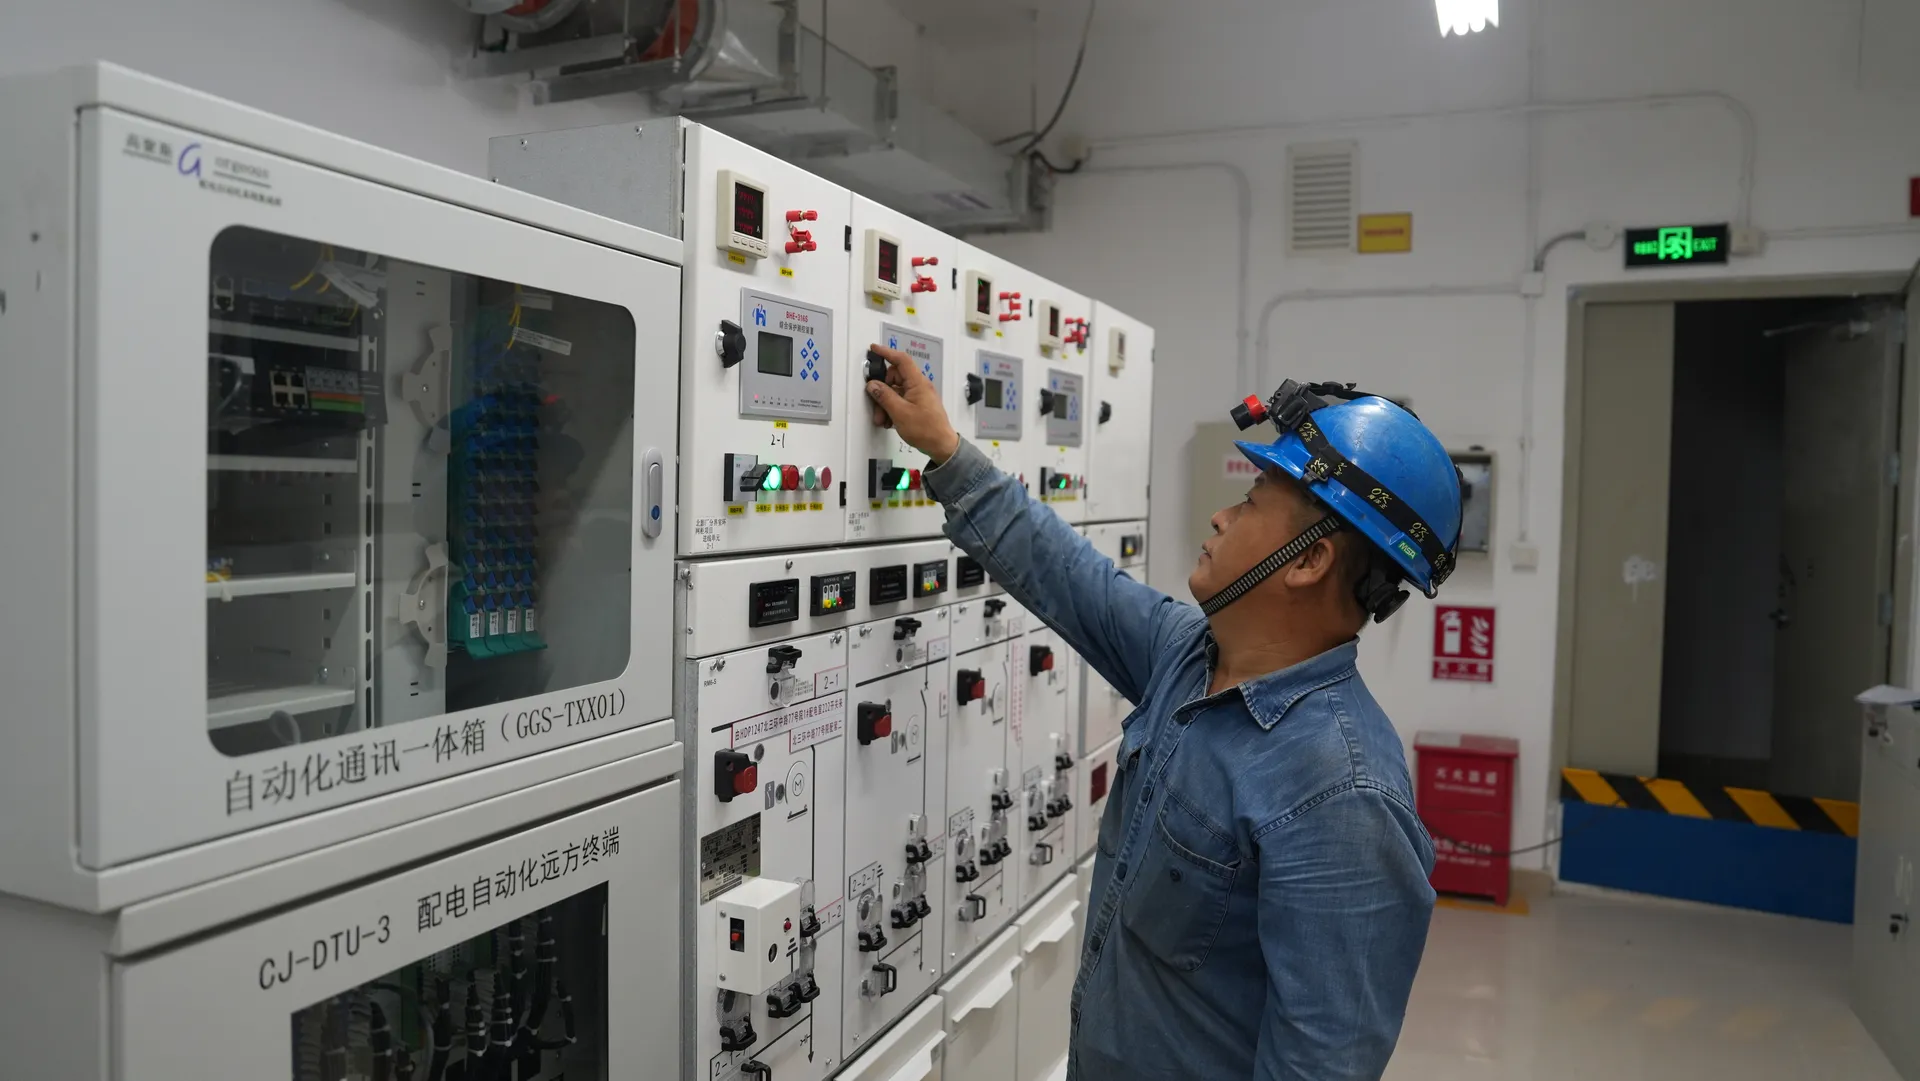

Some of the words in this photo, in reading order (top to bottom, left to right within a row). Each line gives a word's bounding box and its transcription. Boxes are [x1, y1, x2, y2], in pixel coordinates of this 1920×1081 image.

[770, 432, 785, 449] 2-1
[1398, 541, 1417, 560] MSA
[703, 679, 717, 687] RM6-S
[823, 673, 839, 690] 2-1
[852, 869, 876, 893] 2-2-7
[258, 914, 392, 991] CJ-DTU-3
[417, 825, 621, 934] 配电自动化远方终端
